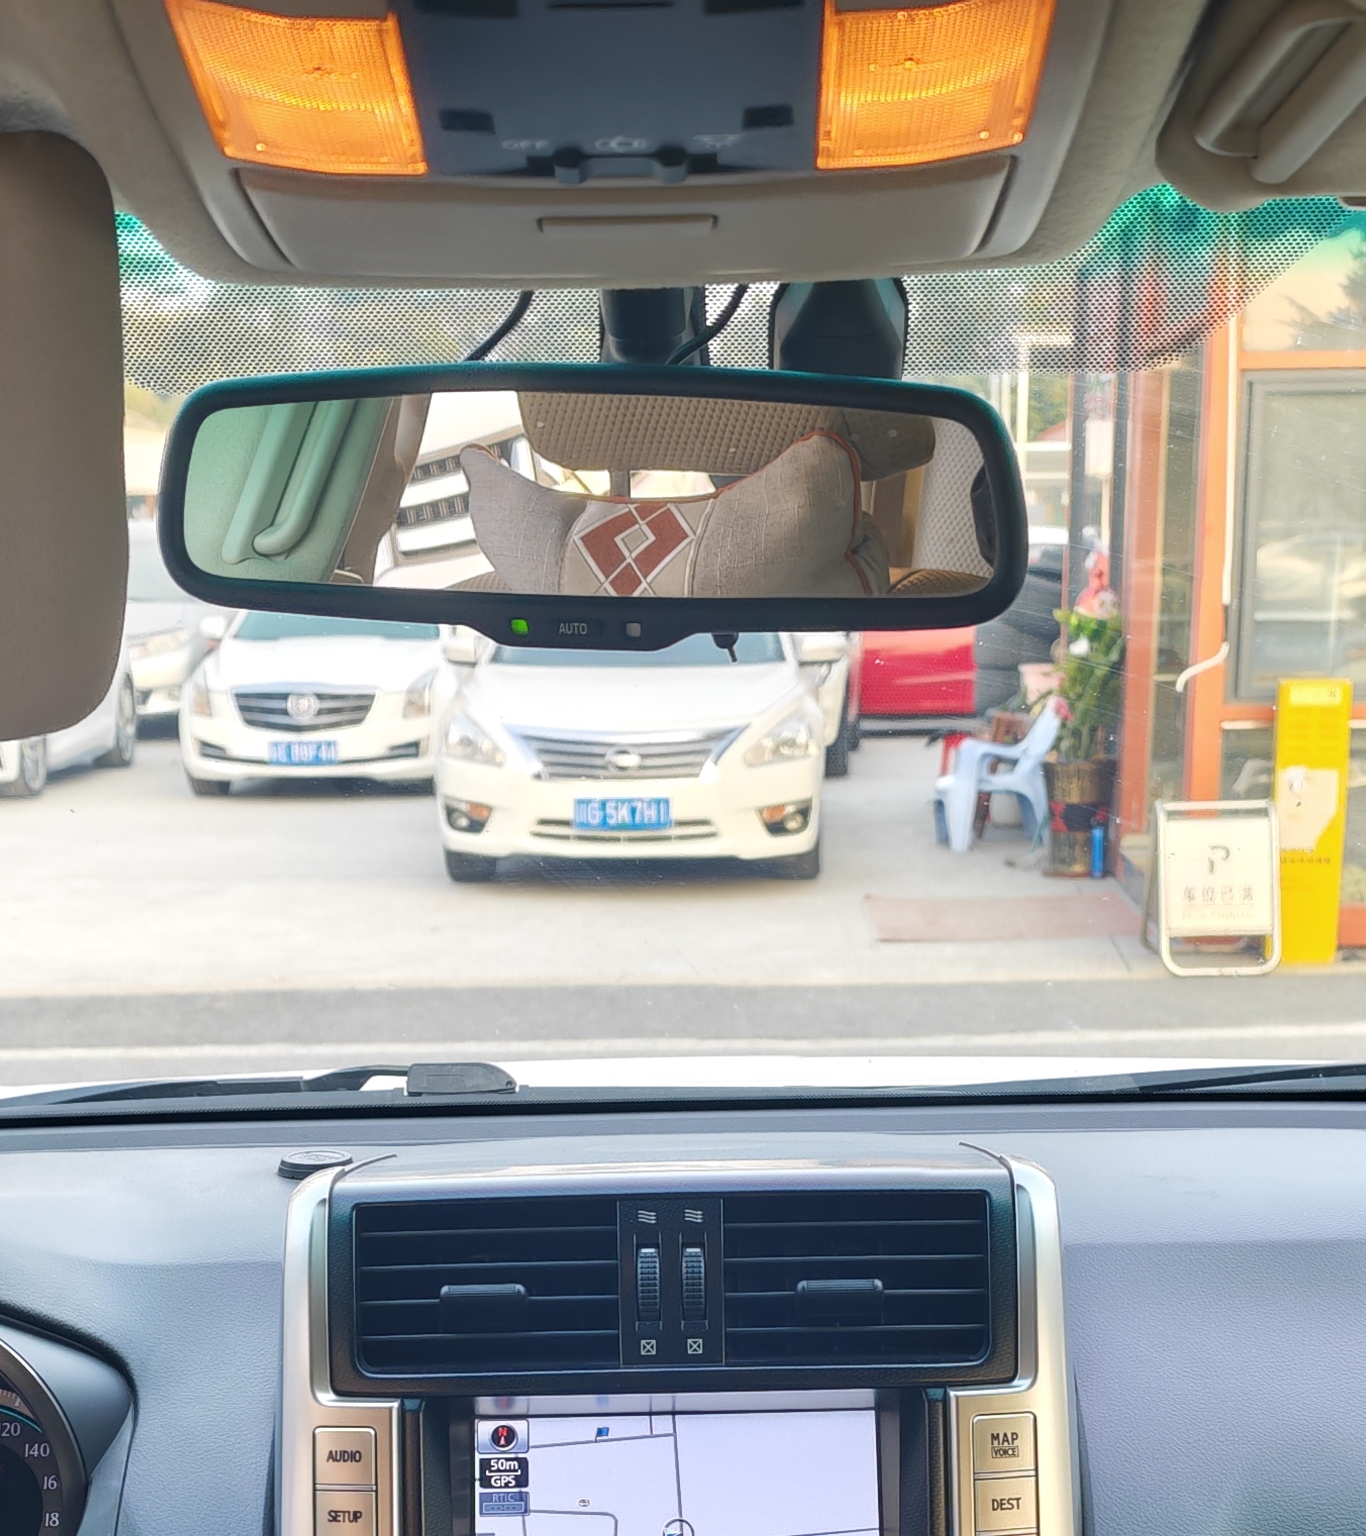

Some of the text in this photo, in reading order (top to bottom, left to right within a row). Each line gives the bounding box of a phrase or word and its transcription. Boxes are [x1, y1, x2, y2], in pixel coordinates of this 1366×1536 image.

[558, 622, 588, 635] AUTO
[990, 1432, 1019, 1446] MAP
[24, 1443, 50, 1457] 140
[993, 1446, 1017, 1457] VOICE
[326, 1450, 362, 1464] AUDIO
[490, 1459, 519, 1471] 50m
[490, 1475, 516, 1488] GPS
[492, 1494, 514, 1503] RTIC
[991, 1497, 1022, 1512] DEST
[327, 1510, 363, 1523] SETUP
